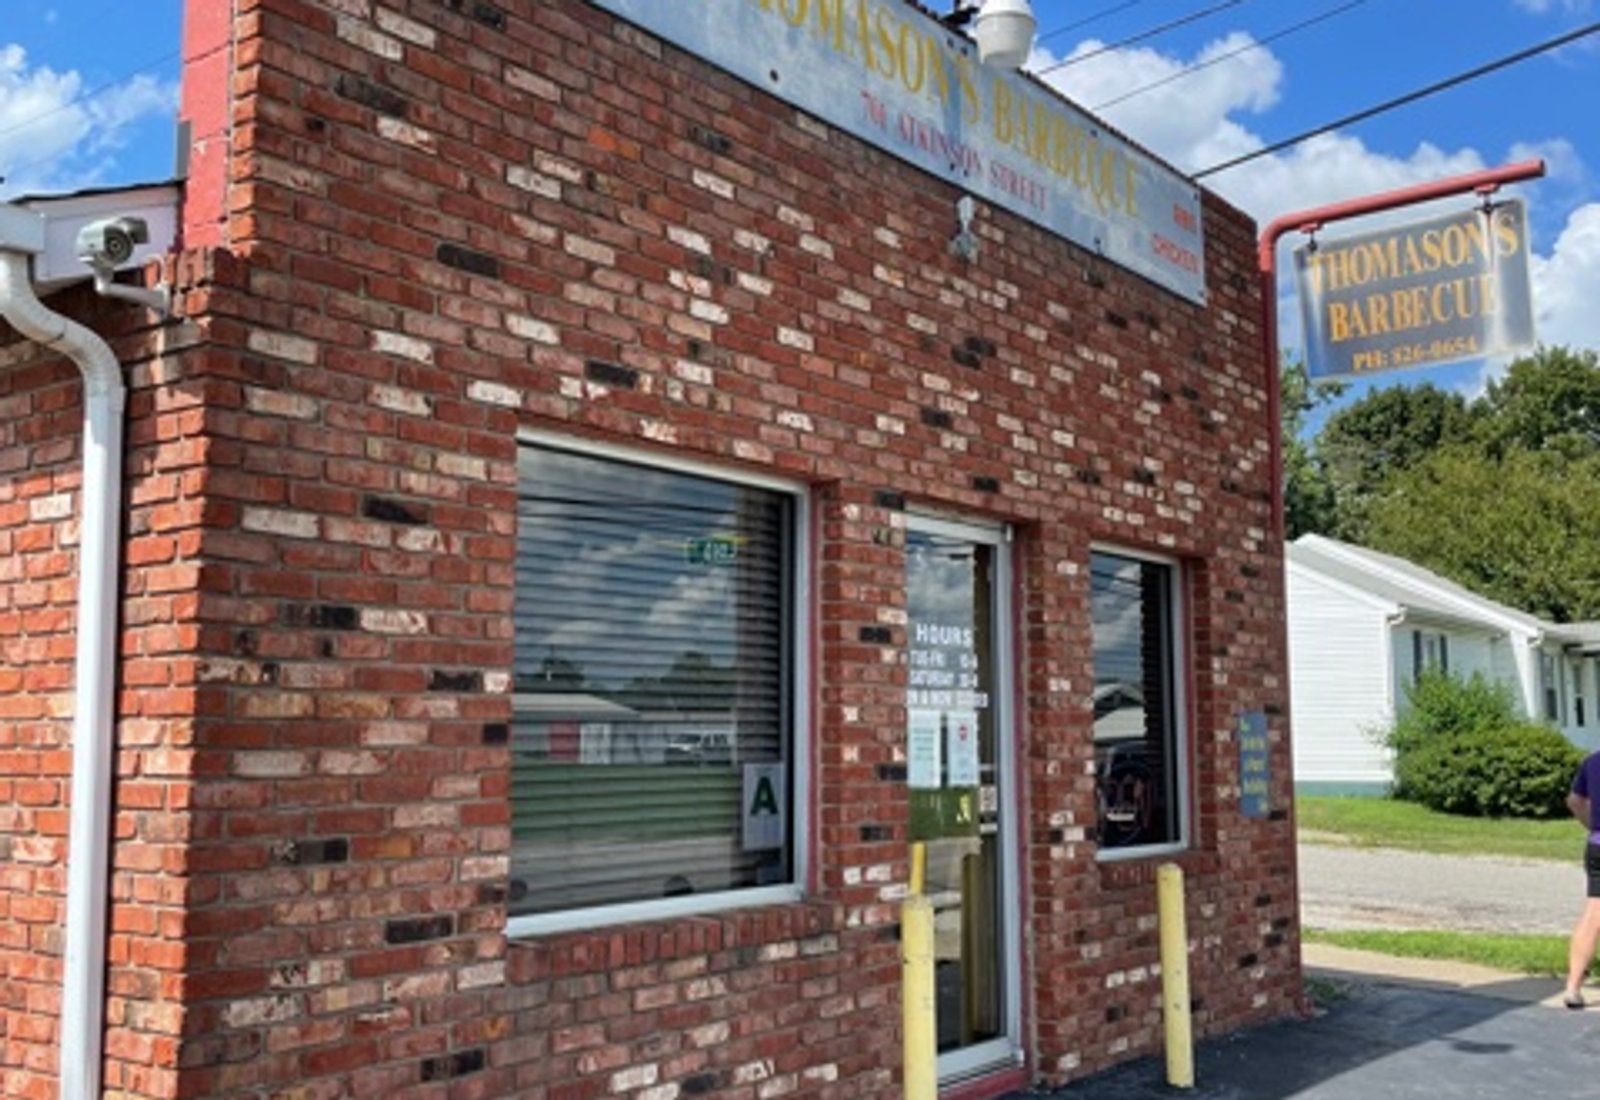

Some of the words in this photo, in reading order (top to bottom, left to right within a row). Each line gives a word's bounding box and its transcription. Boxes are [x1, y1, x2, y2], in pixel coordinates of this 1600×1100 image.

[897, 110, 982, 173] ATKINSON
[990, 159, 1048, 213] STREET
[1305, 211, 1520, 300] THOMASONS
[1328, 273, 1499, 342] BARBECUE
[1352, 349, 1389, 372] PH:
[915, 622, 973, 648] HOURS
[749, 776, 779, 816] A
